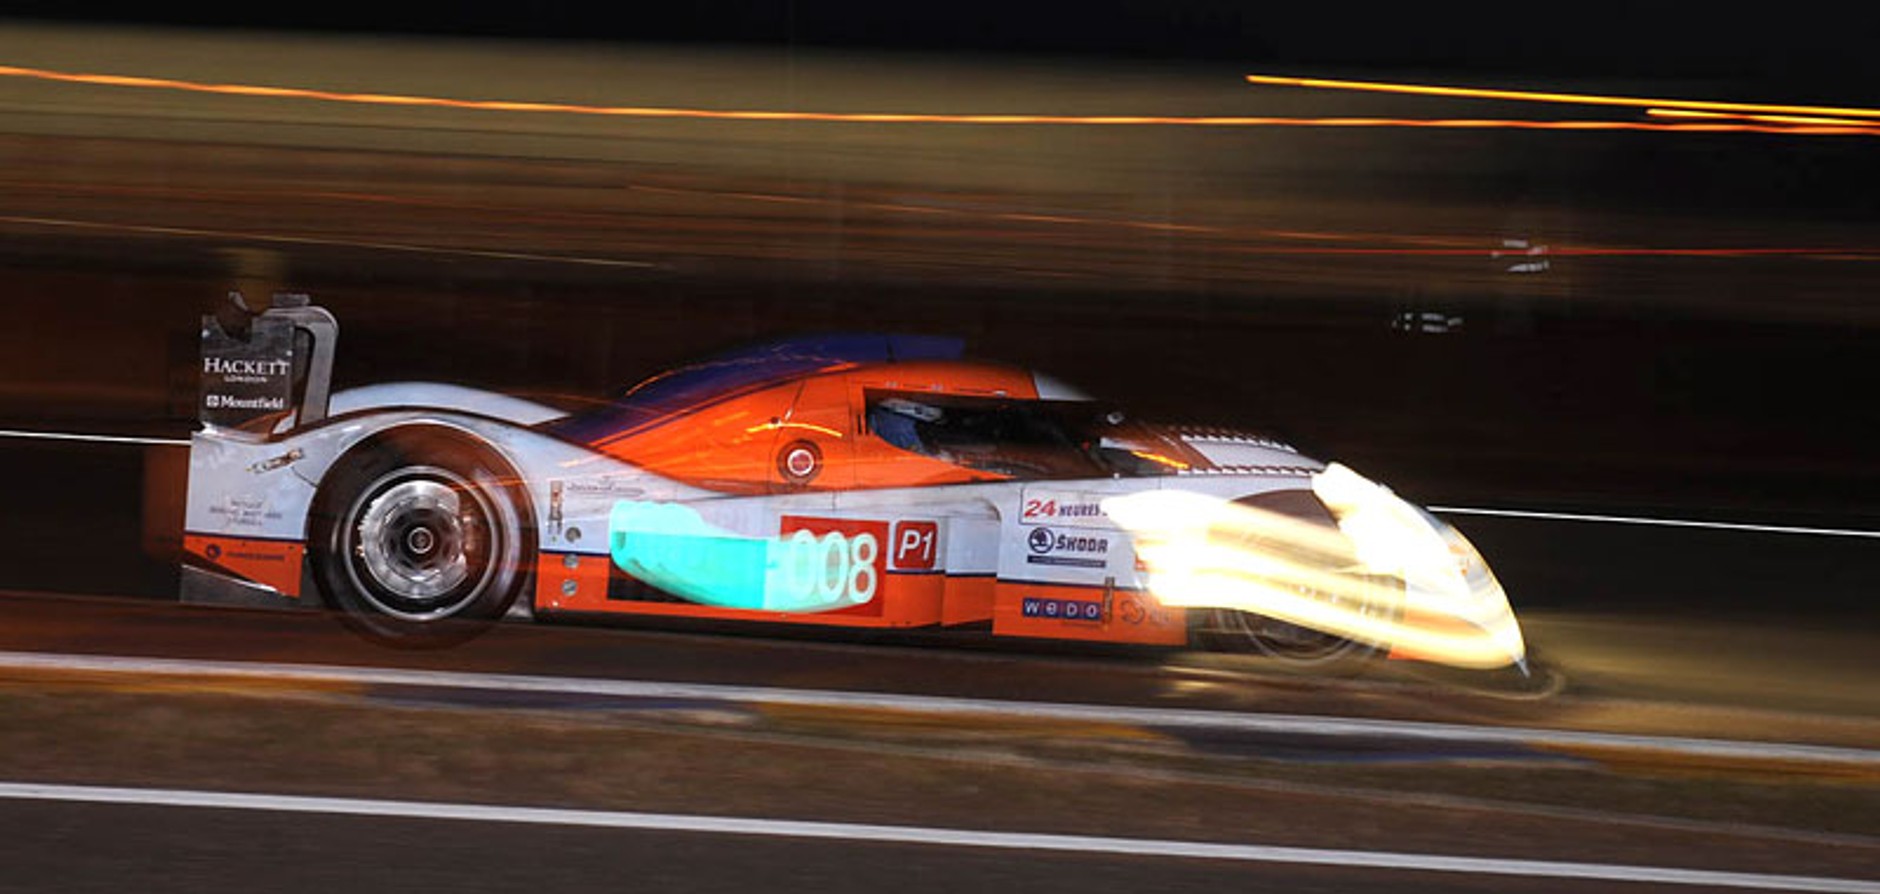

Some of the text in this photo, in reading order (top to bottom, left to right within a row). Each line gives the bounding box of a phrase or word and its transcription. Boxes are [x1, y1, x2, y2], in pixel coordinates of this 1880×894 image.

[203, 357, 291, 376] HACKETT
[220, 395, 284, 409] Mountfield
[1024, 499, 1056, 518] 24
[898, 529, 933, 561] P1
[788, 528, 878, 604] 008
